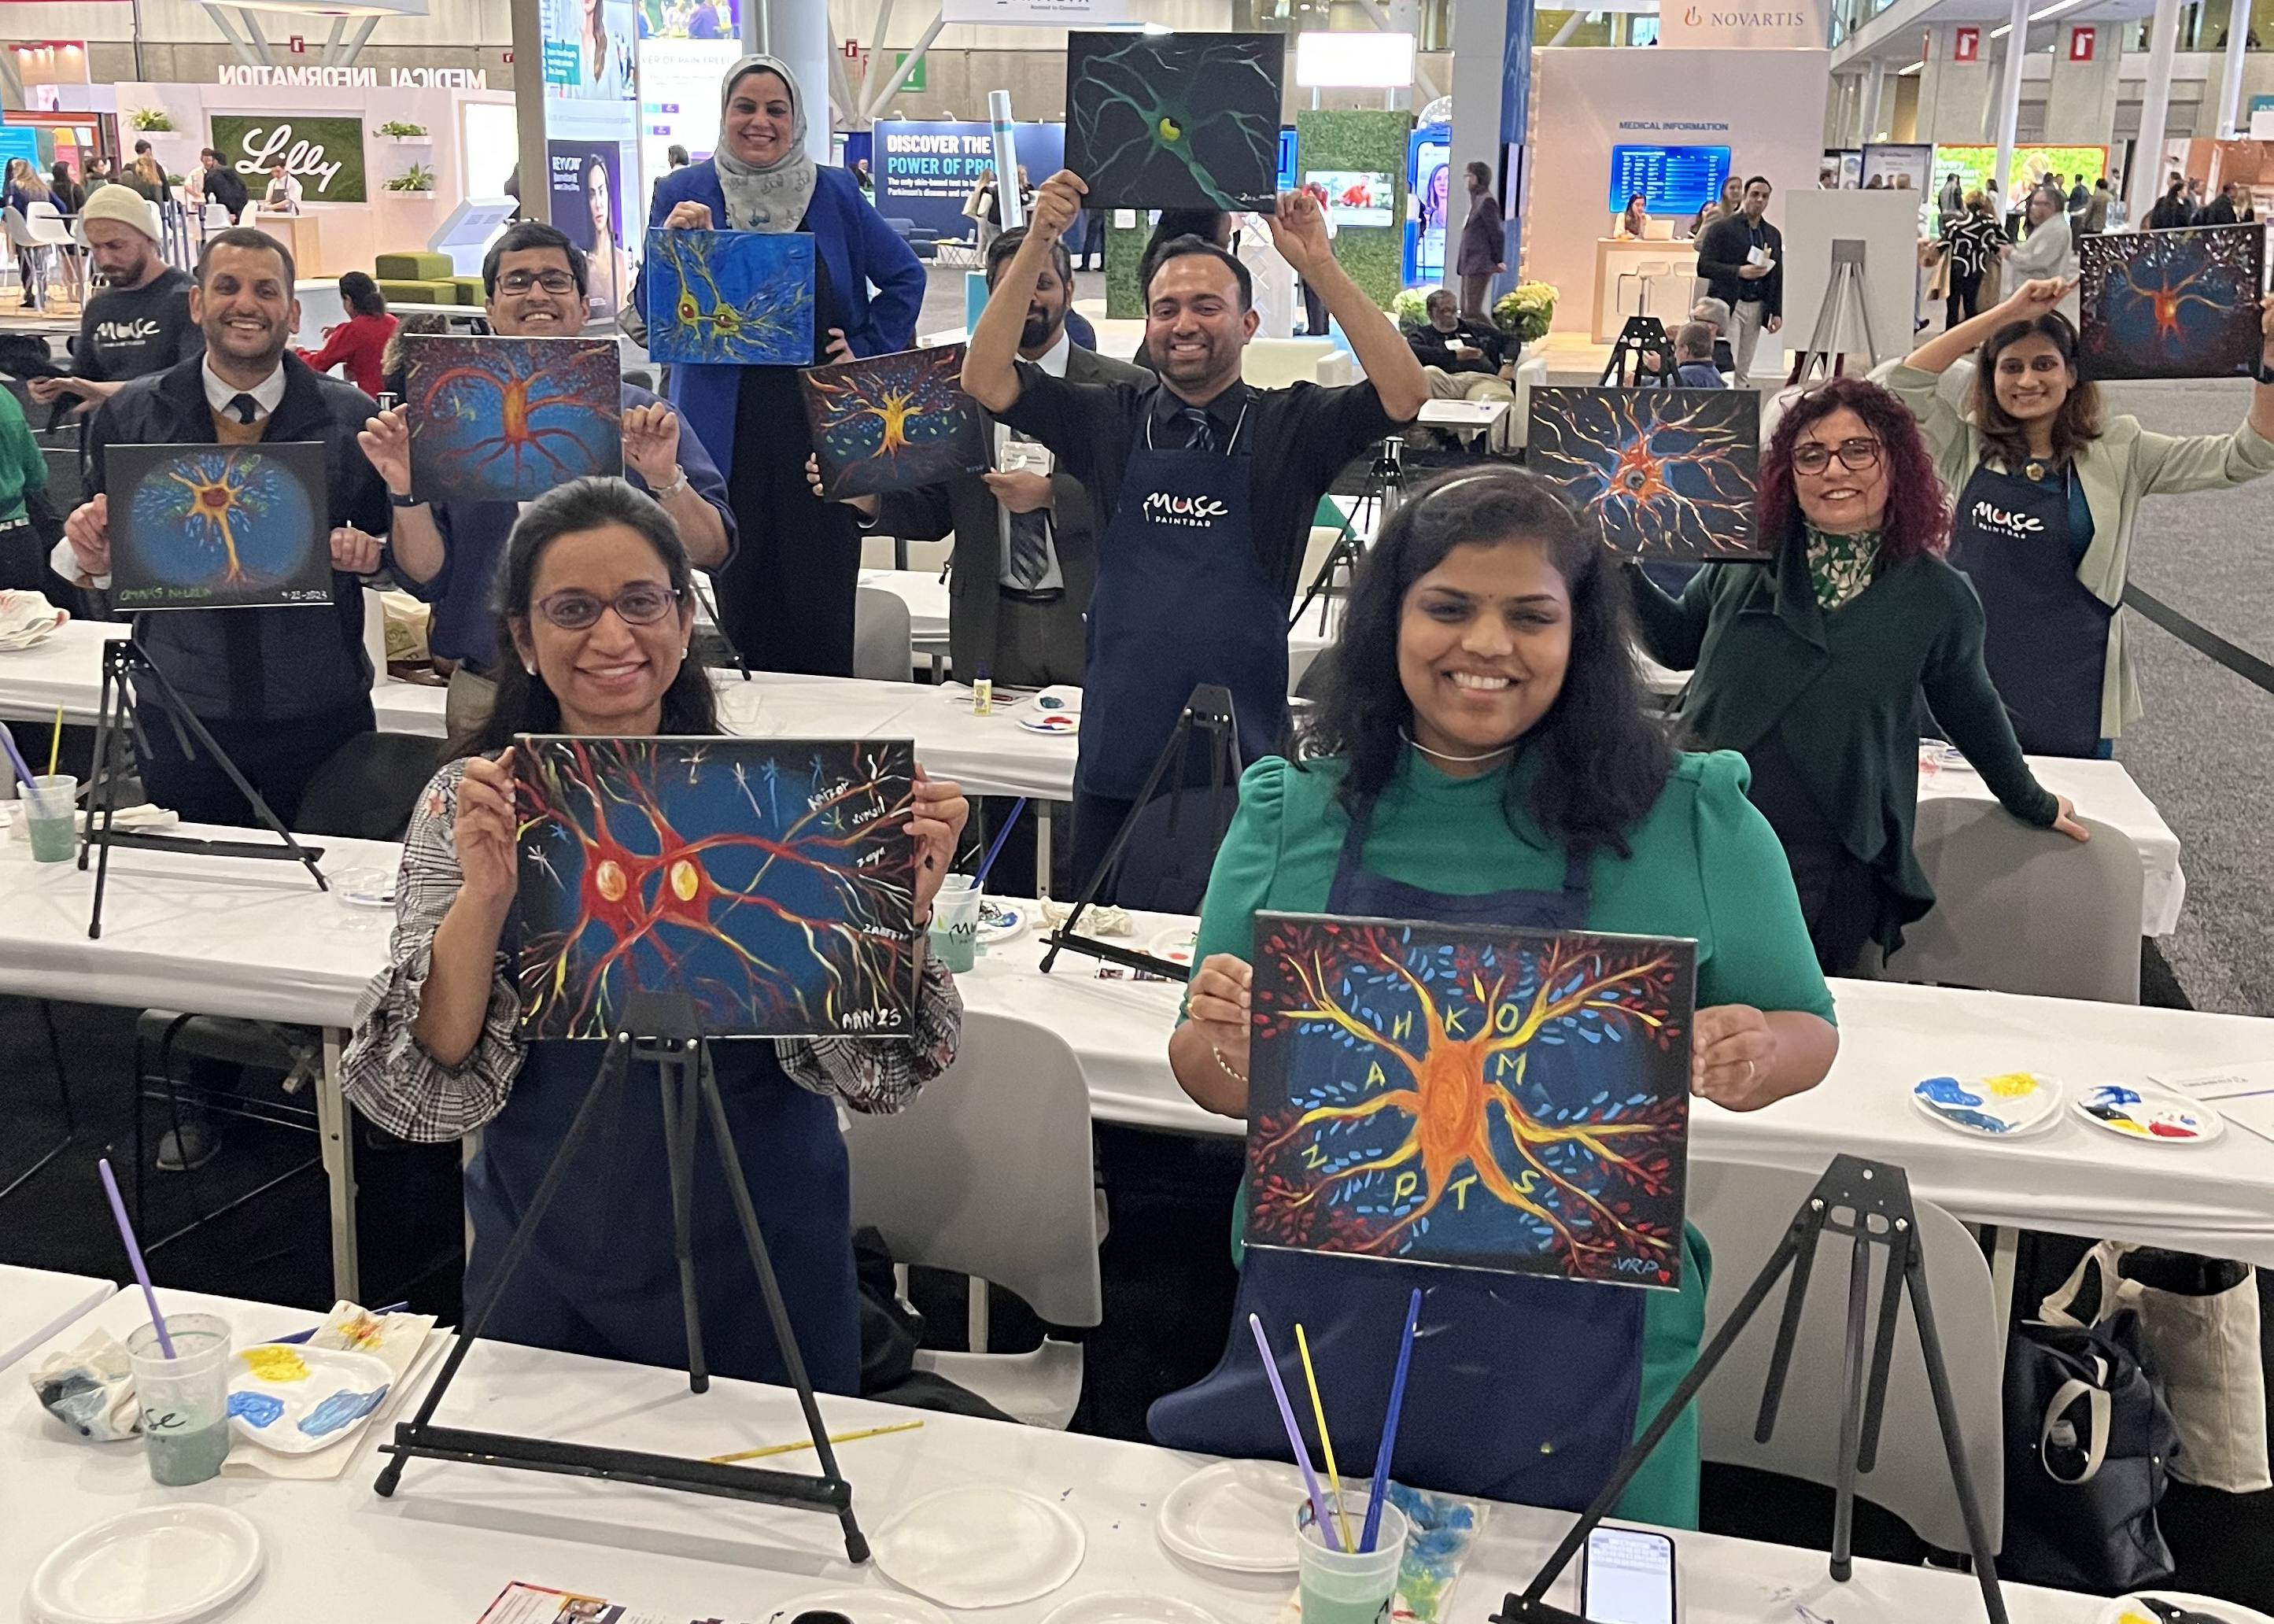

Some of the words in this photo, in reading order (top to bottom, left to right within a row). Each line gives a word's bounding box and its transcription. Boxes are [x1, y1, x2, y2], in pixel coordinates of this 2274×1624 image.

[1711, 12, 1804, 27] NOVARTIS
[1619, 121, 1661, 131] MEDICAL
[1662, 122, 1729, 131] INFORMATION
[887, 135, 959, 154] DISCOVER
[961, 135, 991, 154] THE
[888, 157, 940, 175] POWER
[943, 158, 962, 175] OF
[965, 158, 998, 175] PRO
[1155, 516, 1211, 527] PAINTBAR
[1393, 1010, 1412, 1039] H
[1445, 1005, 1469, 1033] K
[1496, 1003, 1519, 1033] O
[1364, 1061, 1386, 1091] A
[1496, 1051, 1526, 1086] M
[1392, 1171, 1417, 1206] P
[1448, 1174, 1477, 1210] T
[1512, 1169, 1541, 1194] S
